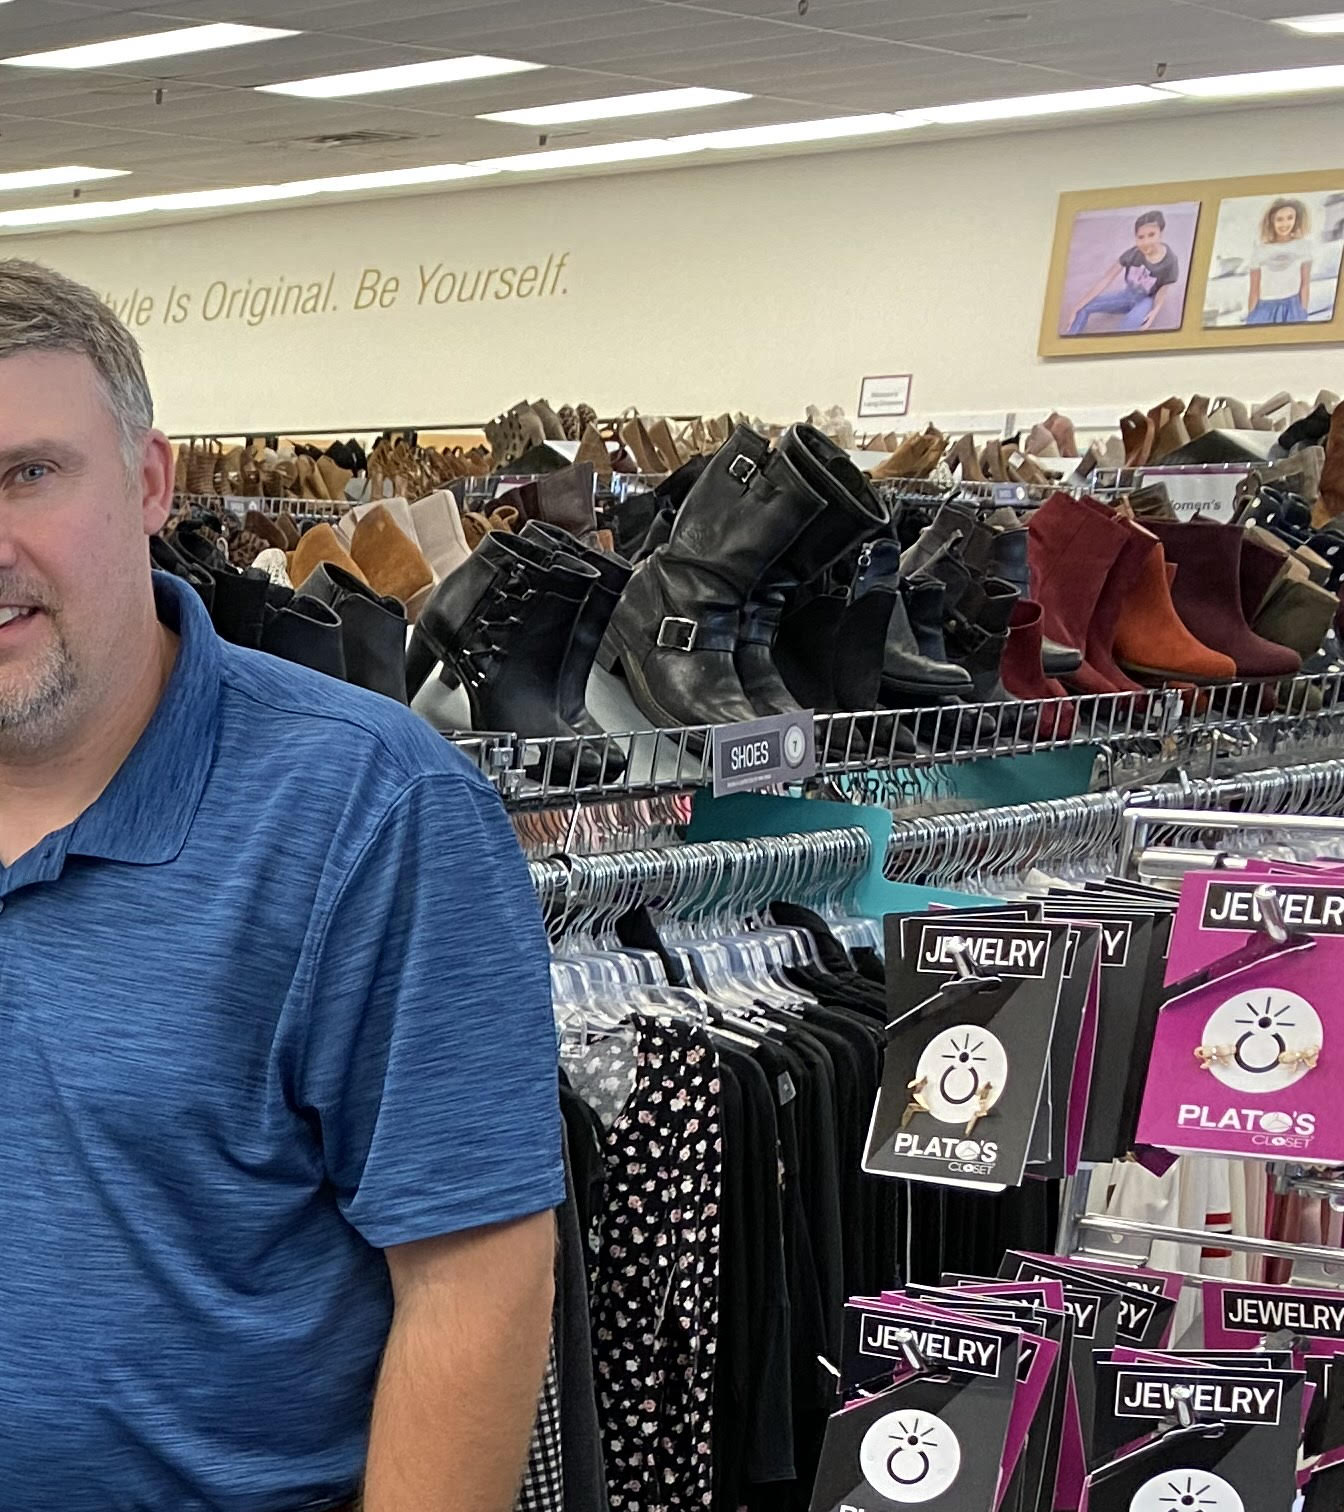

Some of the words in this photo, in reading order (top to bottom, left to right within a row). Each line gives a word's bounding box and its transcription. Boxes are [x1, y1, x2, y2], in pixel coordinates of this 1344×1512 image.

[163, 285, 191, 324] Is
[202, 271, 338, 326] Original.
[353, 268, 400, 310] Be
[417, 251, 571, 305] Yourself.
[731, 741, 769, 770] SHOES
[1252, 1134, 1314, 1149] CLOSET
[948, 1161, 995, 1175] CLOSET
